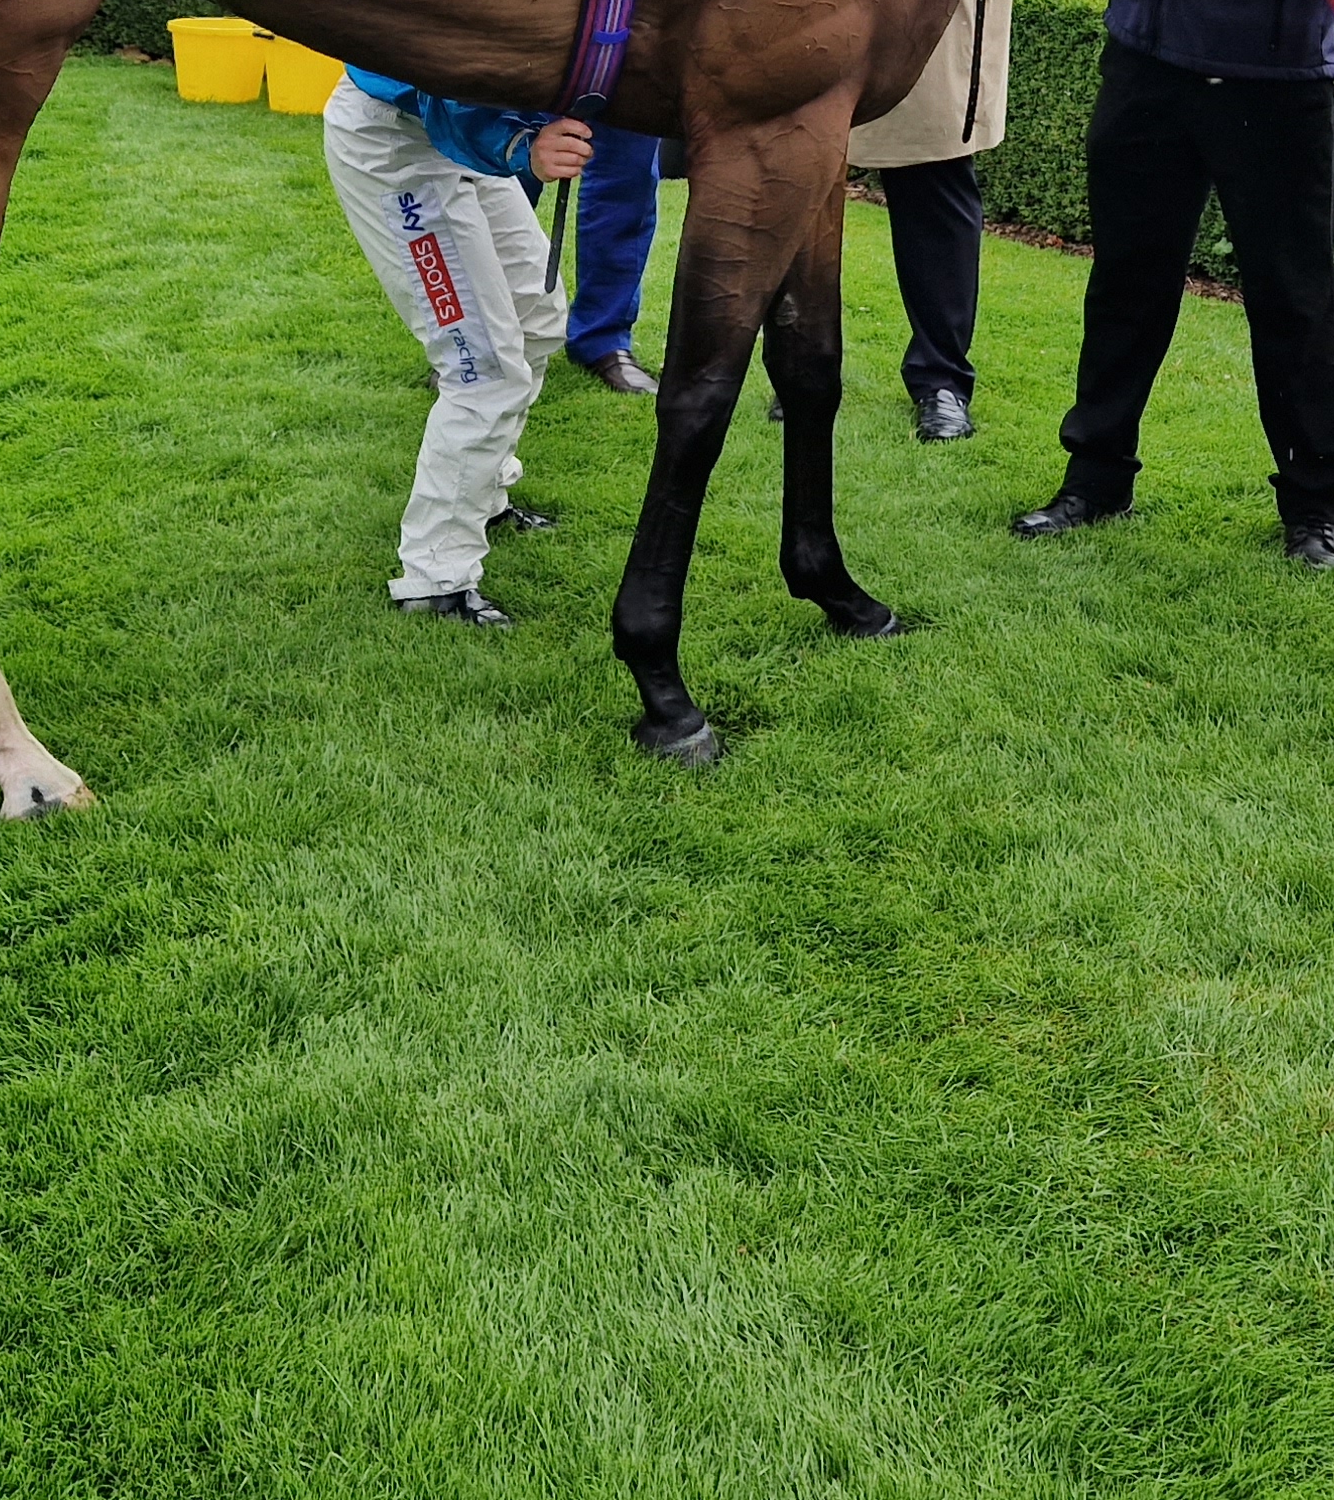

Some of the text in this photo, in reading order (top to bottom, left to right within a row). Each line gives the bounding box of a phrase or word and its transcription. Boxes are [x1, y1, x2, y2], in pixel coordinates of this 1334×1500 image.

[398, 191, 479, 385] sky sports racing
